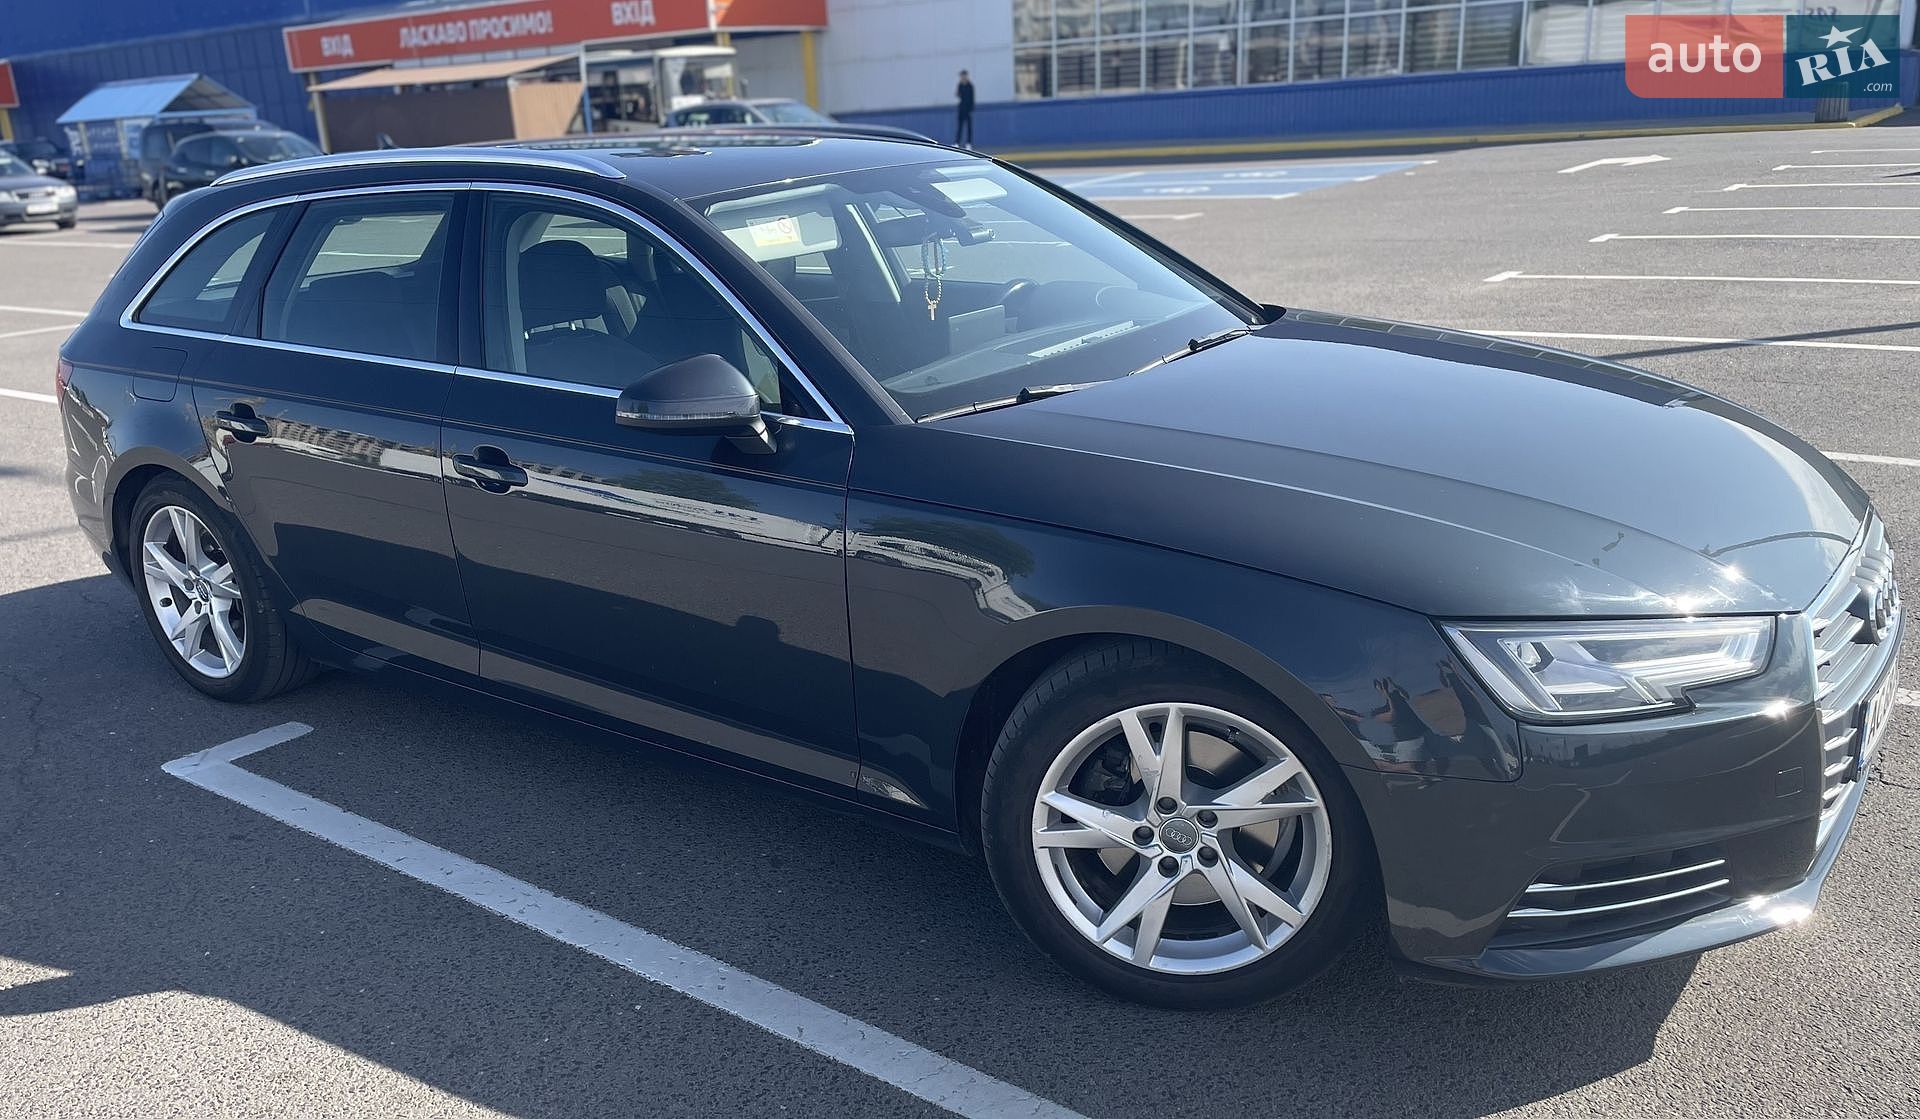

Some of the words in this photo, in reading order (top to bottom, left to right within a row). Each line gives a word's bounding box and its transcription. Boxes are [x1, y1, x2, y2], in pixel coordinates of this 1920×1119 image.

[611, 0, 656, 26] ВХІД
[400, 20, 467, 48] ЛАСКАВО
[468, 10, 553, 41] ПРОСИМО!
[320, 33, 354, 57] ВХІД
